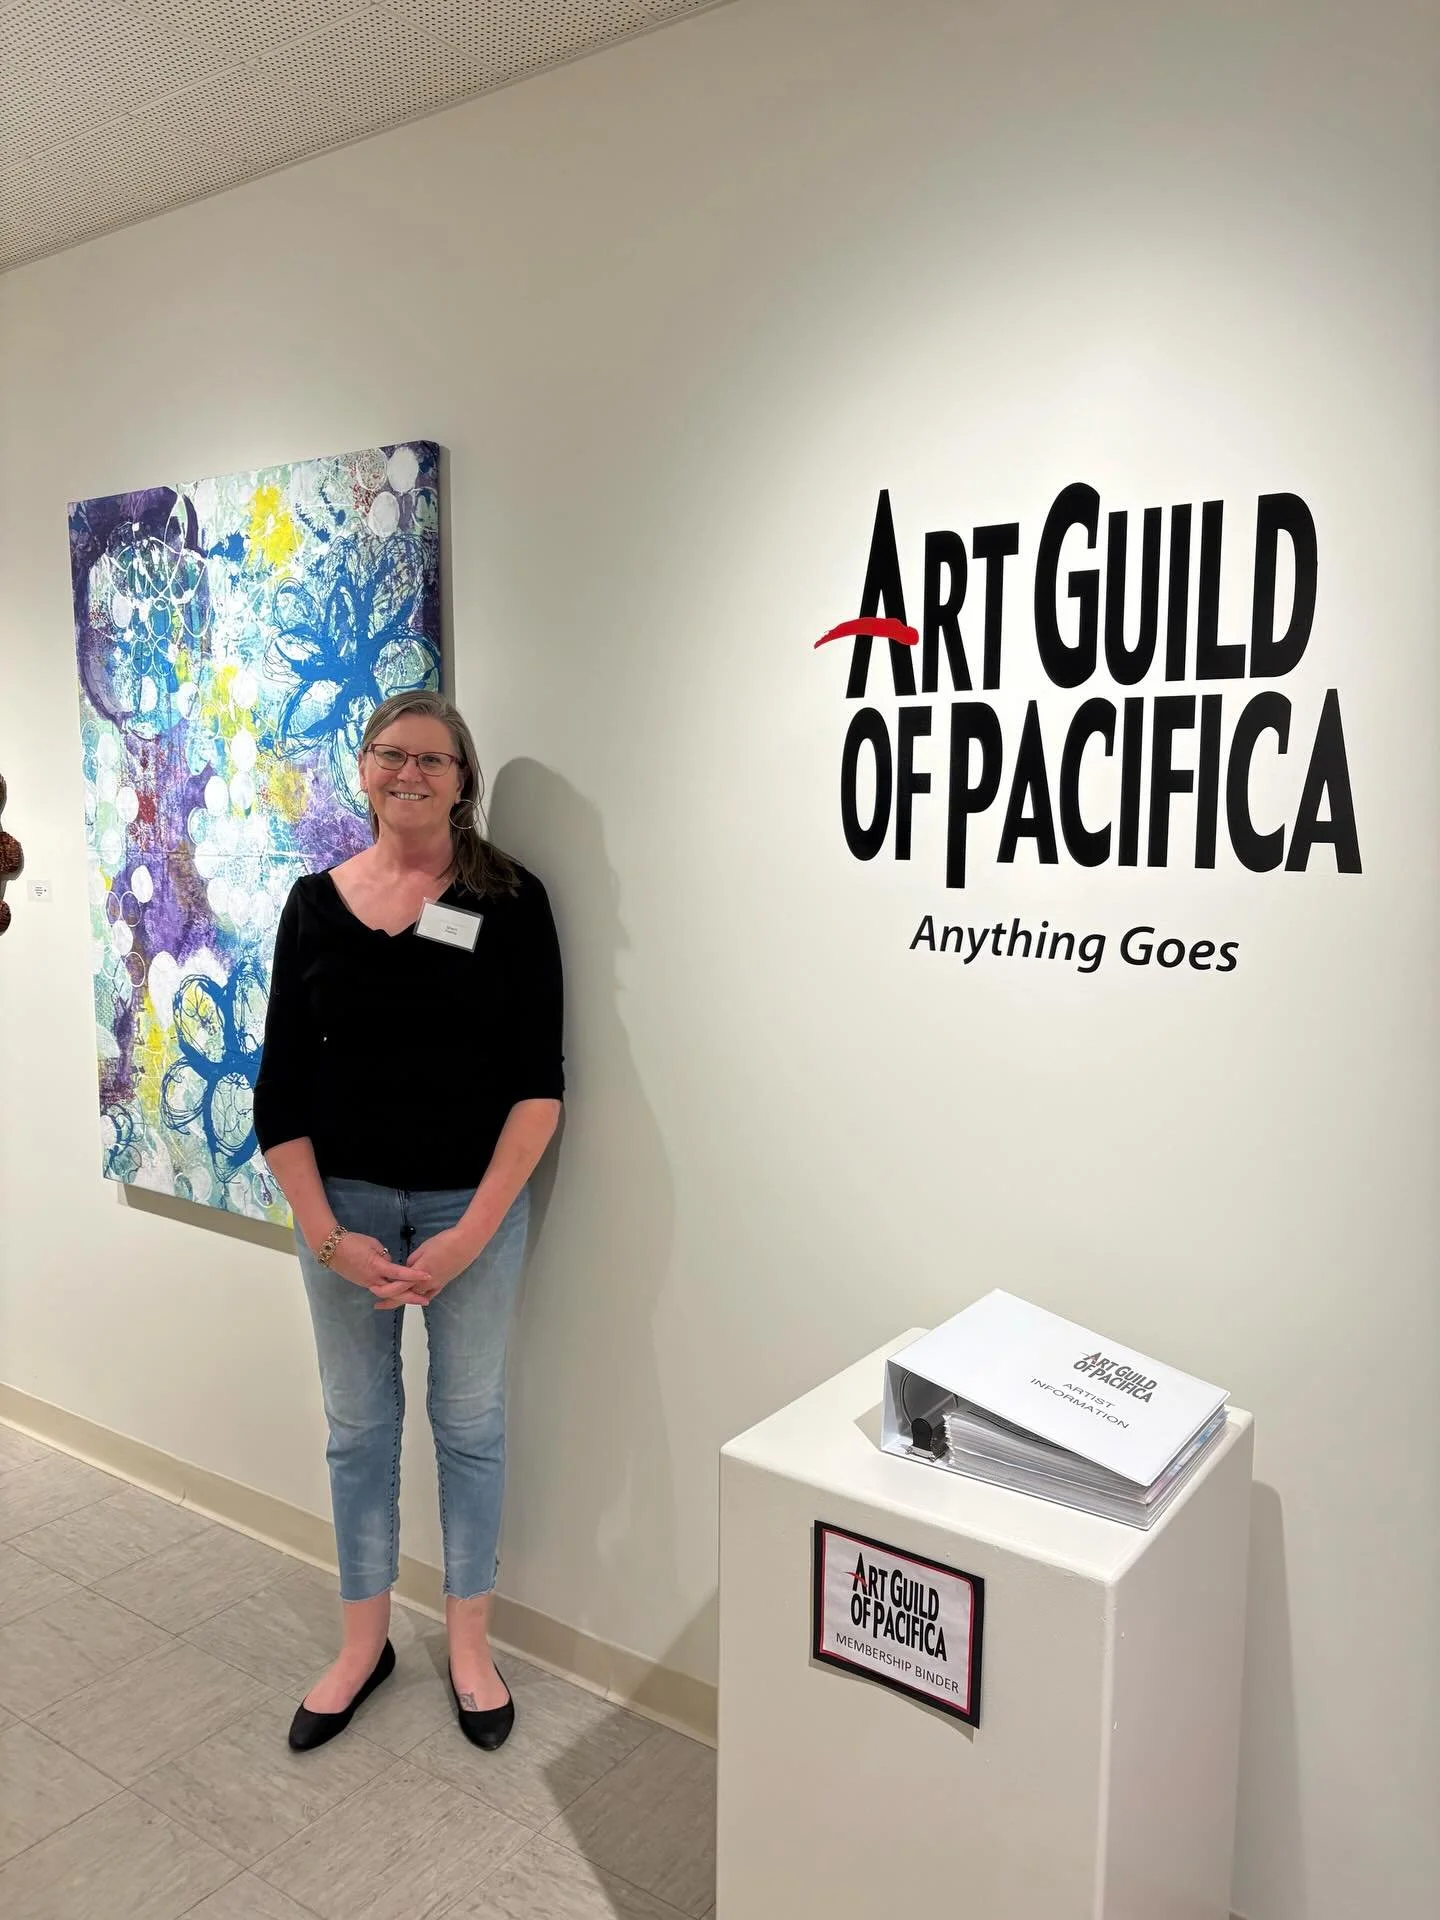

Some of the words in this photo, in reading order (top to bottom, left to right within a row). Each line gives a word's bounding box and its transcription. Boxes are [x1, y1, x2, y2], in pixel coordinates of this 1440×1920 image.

[814, 488, 1020, 699] ART
[1034, 482, 1318, 689] GUILD
[840, 705, 933, 861] OF
[946, 688, 1363, 889] PACIFICA
[909, 914, 1107, 974] Anything
[1119, 925, 1240, 973] Goes
[1062, 1383, 1116, 1408] ARTIST
[1073, 1360, 1097, 1373] OF
[1088, 1367, 1153, 1403] PACIFICA
[1081, 1352, 1119, 1371] ART
[1114, 1366, 1158, 1390] GUILD
[1030, 1378, 1130, 1429] INFORMATION
[847, 1551, 888, 1602] ART
[890, 1569, 940, 1622] GUILD
[850, 1593, 871, 1629] OF
[873, 1599, 948, 1662] PACIFICA
[836, 1632, 912, 1672] MEMBERSHIP
[915, 1665, 959, 1694] BINDER
